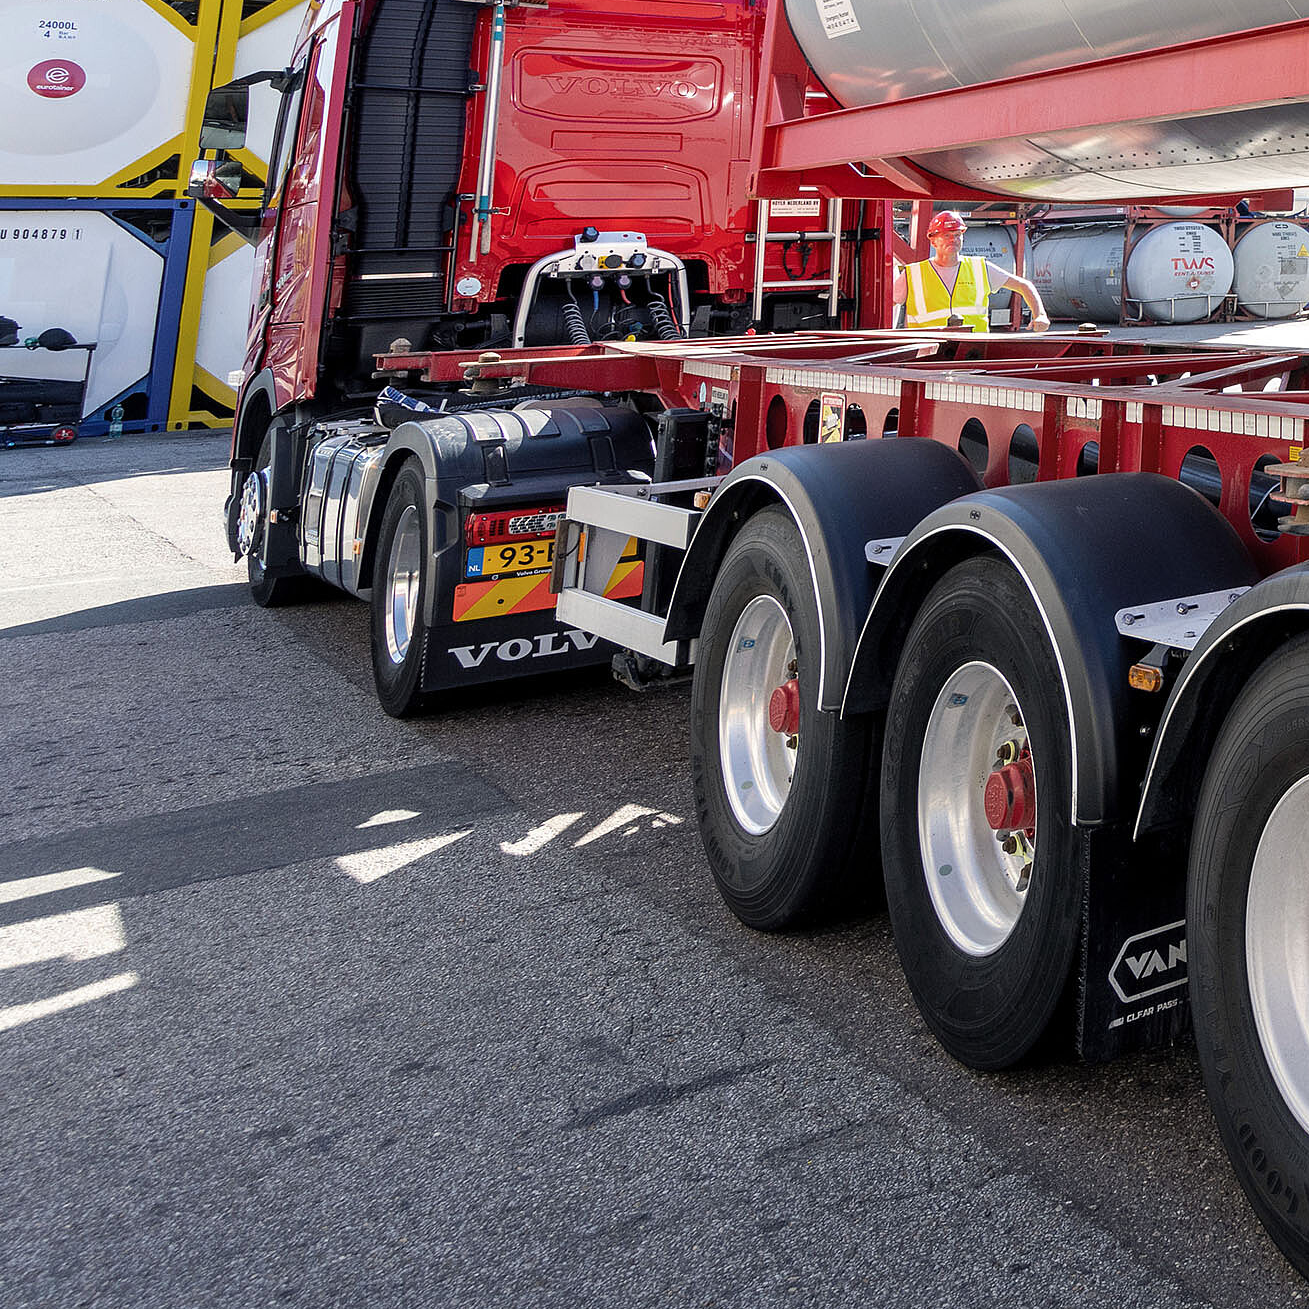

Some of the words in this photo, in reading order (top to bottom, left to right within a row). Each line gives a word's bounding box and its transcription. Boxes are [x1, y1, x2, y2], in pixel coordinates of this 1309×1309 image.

[39, 20, 78, 30] 24000L
[36, 84, 75, 92] eurotainer
[541, 76, 698, 99] VOLVO
[13, 228, 67, 241] 904879
[1171, 257, 1215, 270] TWS
[1157, 998, 1178, 1012] PASS
